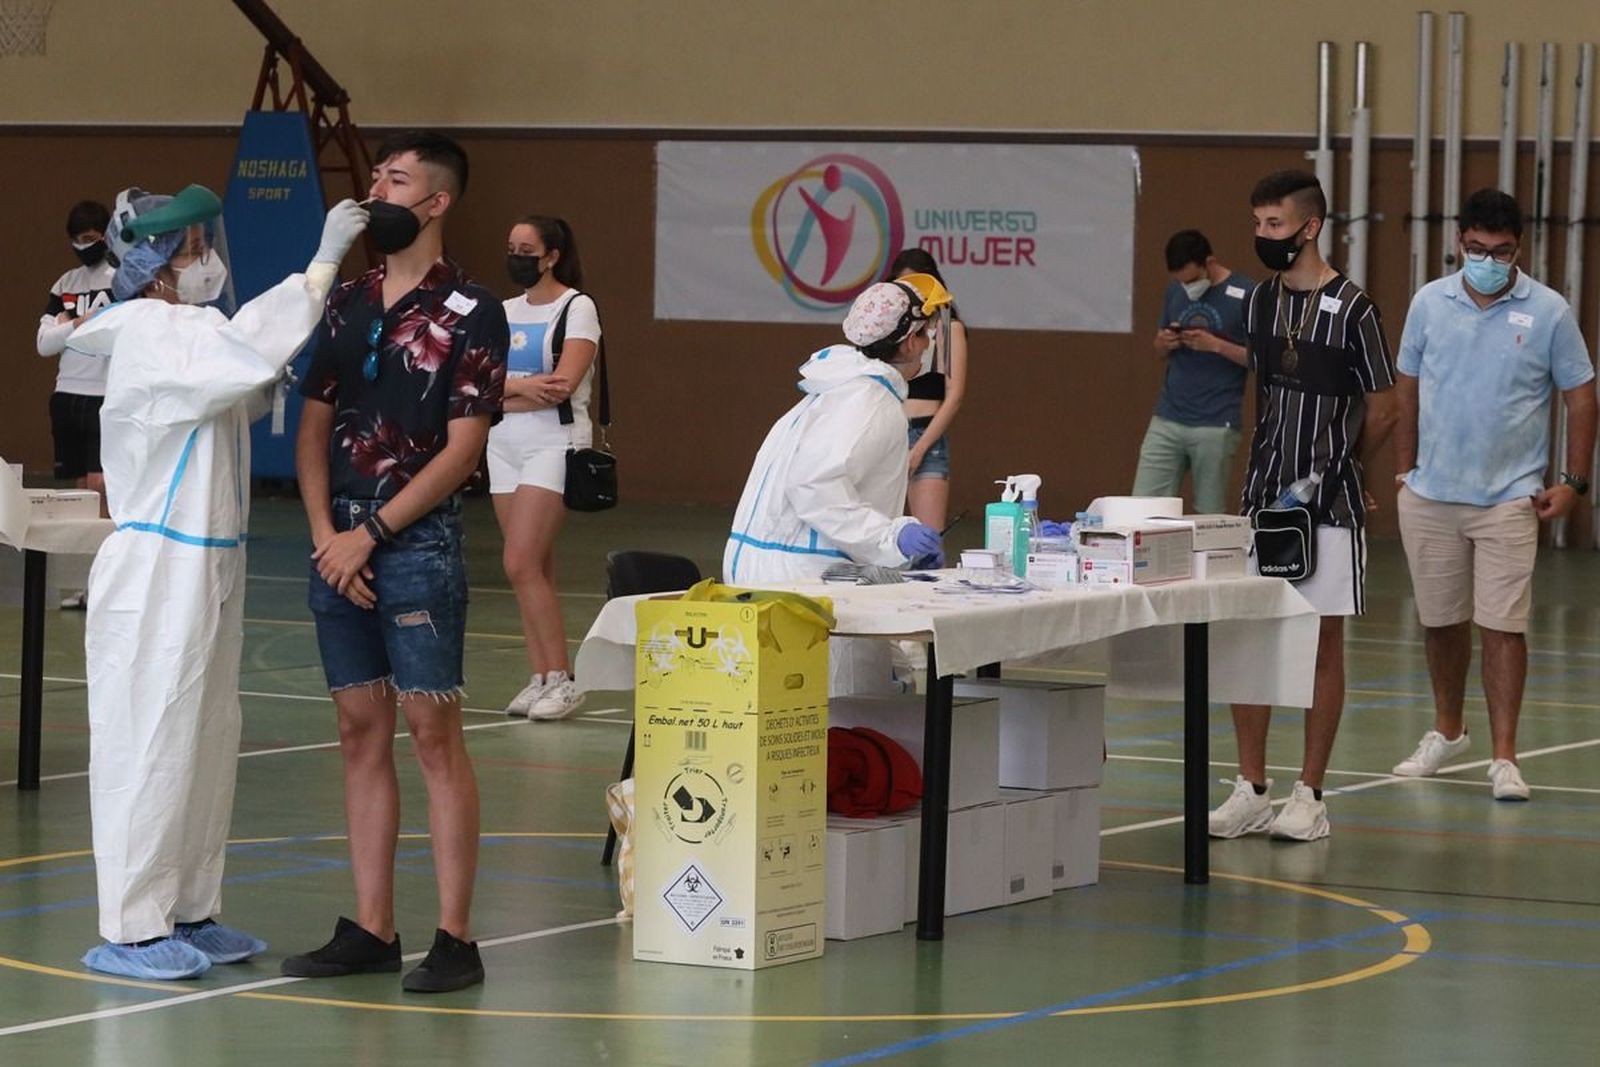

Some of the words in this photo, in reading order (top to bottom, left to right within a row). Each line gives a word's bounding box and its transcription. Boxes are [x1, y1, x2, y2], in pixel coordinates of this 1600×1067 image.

[237, 160, 307, 178] NOSHAGA
[247, 187, 291, 201] SPORT
[915, 210, 1038, 232] UNIVERSO
[919, 236, 1037, 267] MUJER
[1261, 565, 1289, 573] adidas
[649, 714, 694, 726] Embal.net
[697, 717, 711, 728] 50
[712, 718, 719, 729] L
[721, 720, 744, 730] haut
[684, 766, 704, 775] Trier
